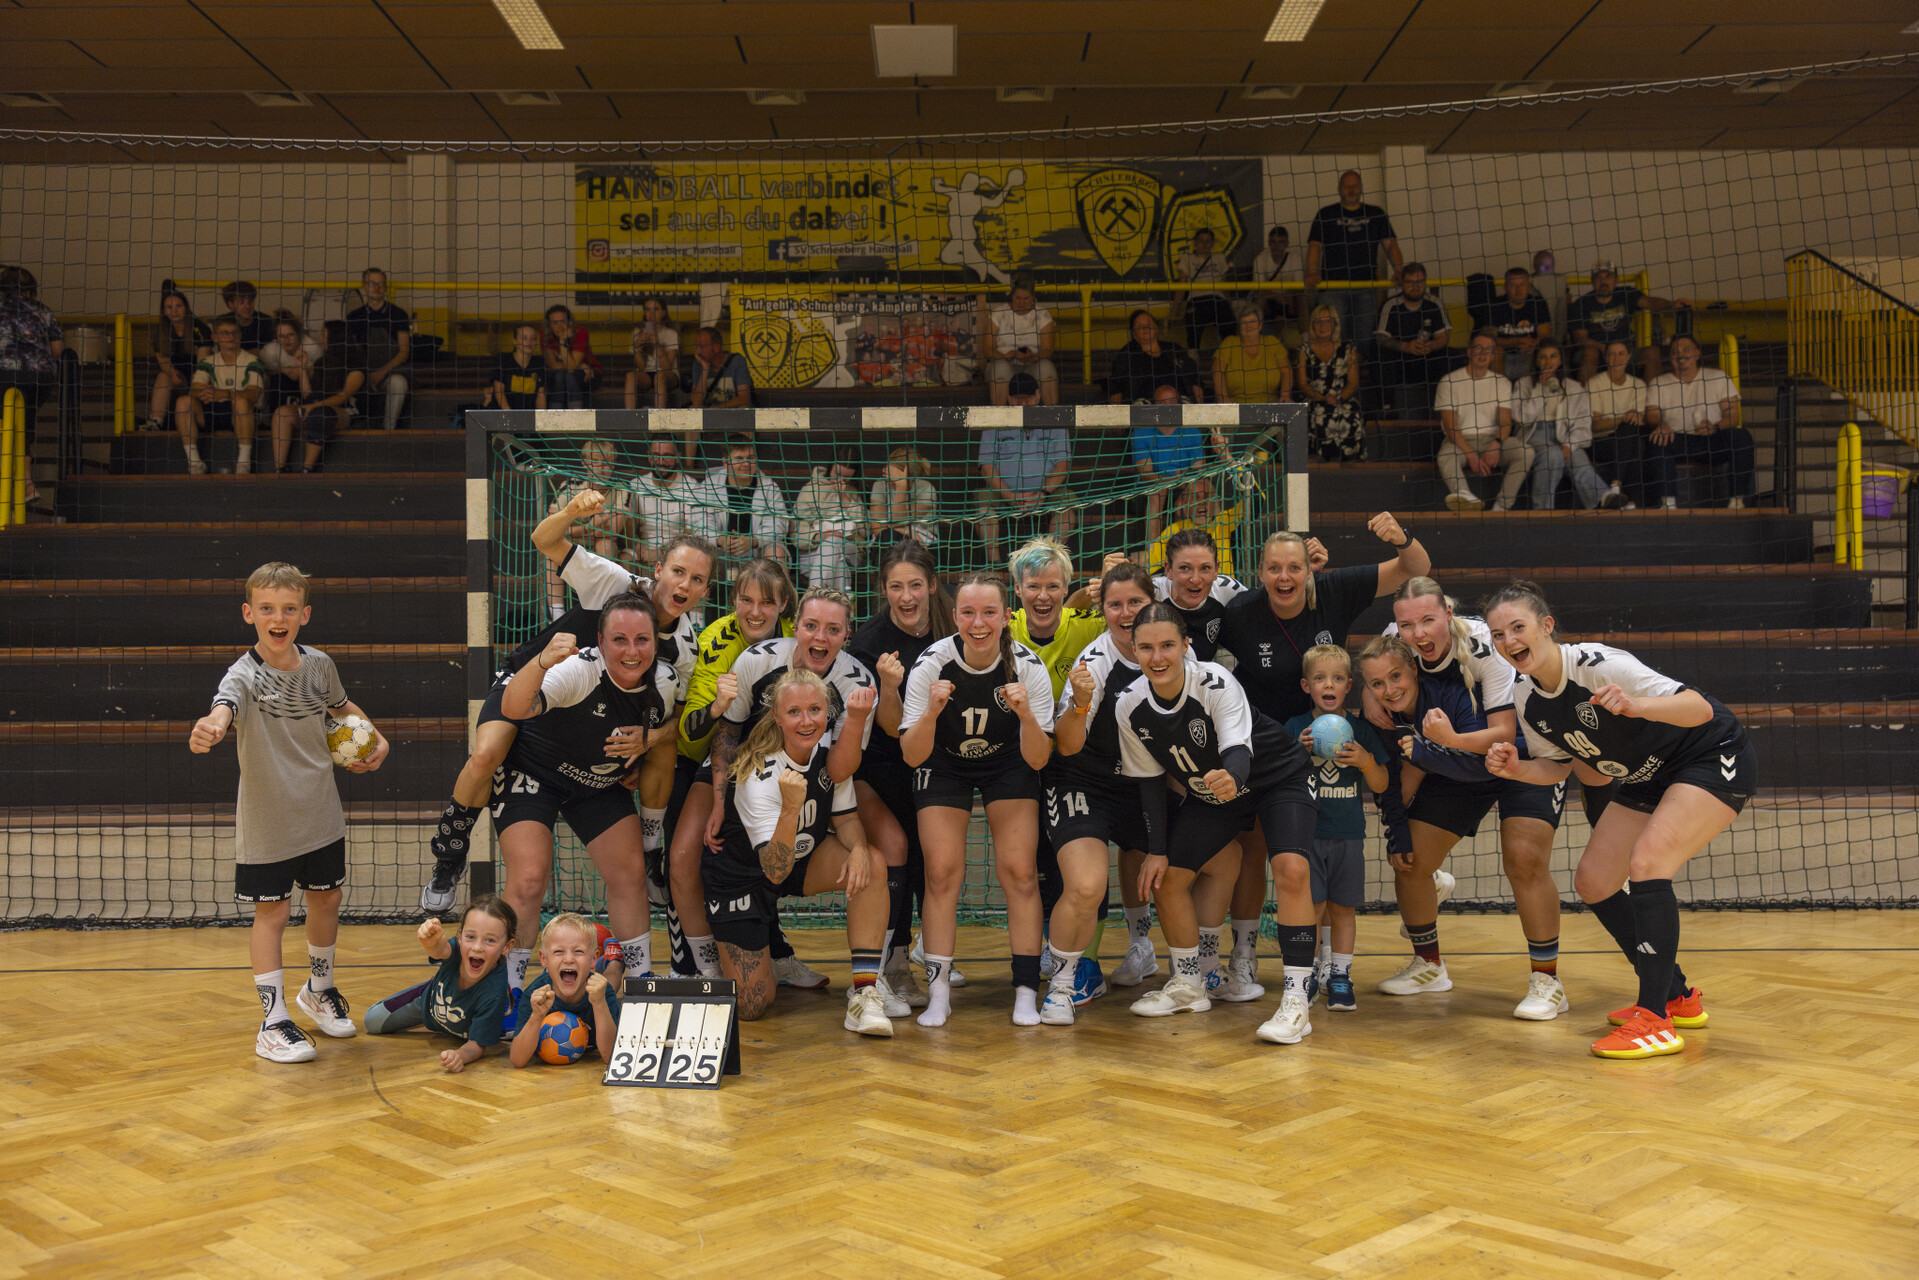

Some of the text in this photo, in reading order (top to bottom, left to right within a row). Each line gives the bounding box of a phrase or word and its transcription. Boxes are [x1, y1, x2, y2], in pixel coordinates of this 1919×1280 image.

[587, 175, 752, 200] HANDBALL
[761, 173, 900, 199] verbindet
[620, 207, 659, 231] sei
[667, 206, 735, 232] auch
[744, 204, 779, 231] du
[789, 204, 868, 230] dabei
[801, 297, 869, 314] Schneeberg,
[871, 300, 918, 316] kämpfen
[922, 300, 929, 312] &
[1261, 657, 1272, 668] CE
[961, 707, 989, 735] 17
[1563, 730, 1601, 758] 99
[1168, 744, 1199, 772] 11
[511, 769, 540, 794] 25
[915, 767, 932, 790] 17
[1319, 781, 1358, 799] mmel
[1062, 791, 1090, 818] 14
[611, 1052, 658, 1080] 32
[669, 1054, 718, 1082] 25
